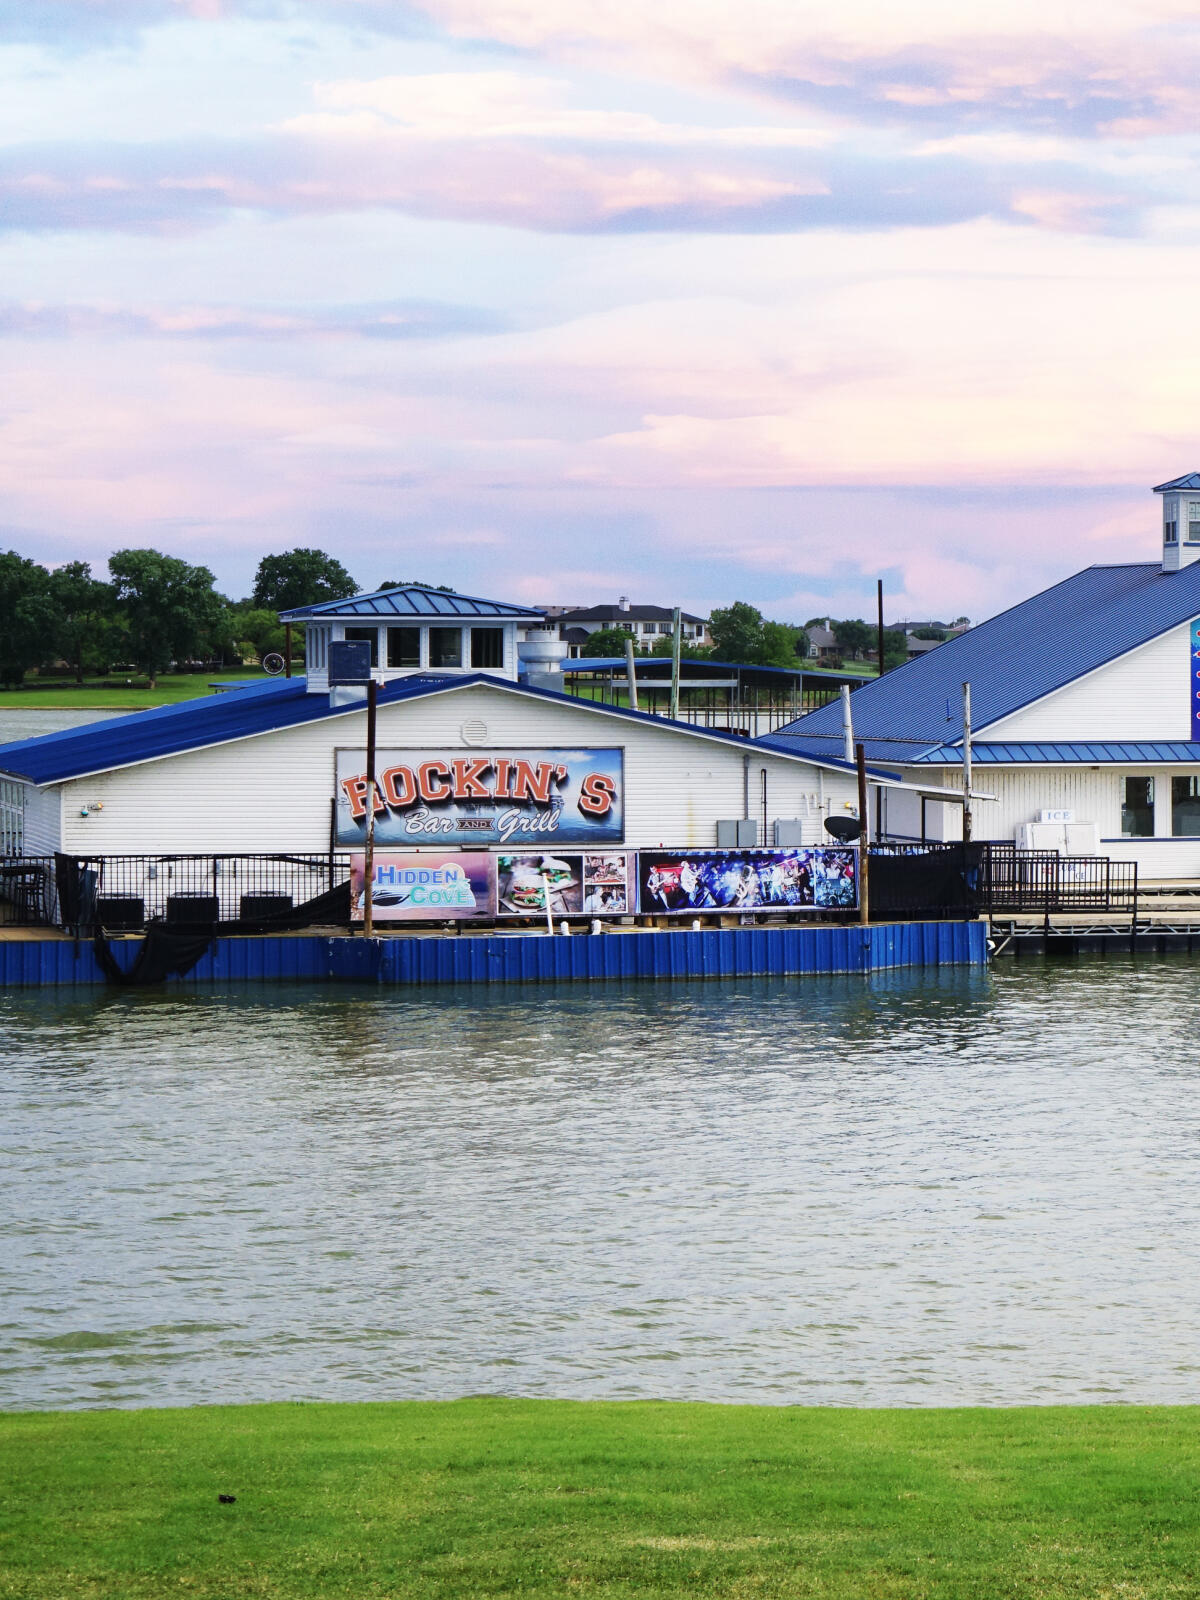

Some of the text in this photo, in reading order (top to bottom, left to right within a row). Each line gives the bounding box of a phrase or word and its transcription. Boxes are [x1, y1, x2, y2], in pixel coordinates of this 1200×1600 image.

[404, 808, 561, 842] Bar AND Grill
[1047, 811, 1070, 820] ICE
[376, 866, 459, 885] HIDDEN
[410, 886, 470, 905] COVE
